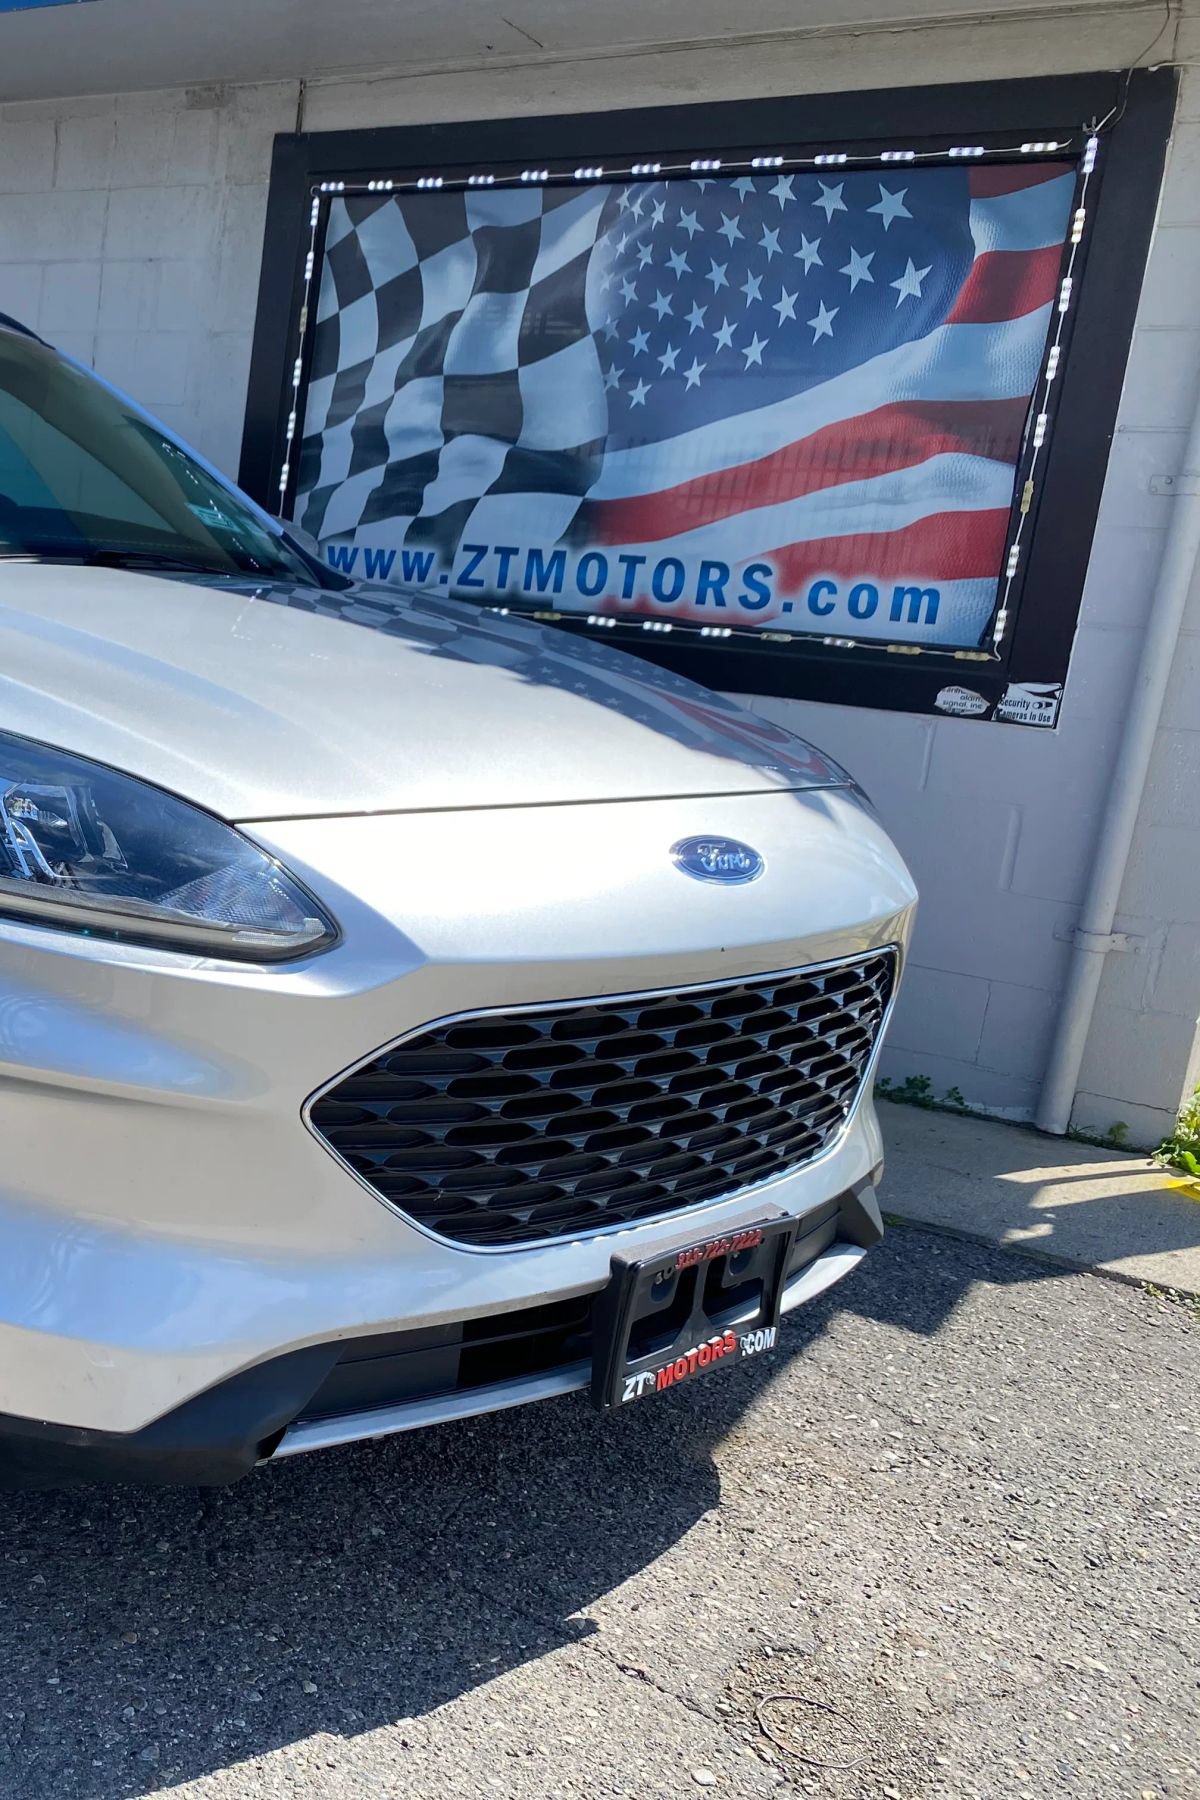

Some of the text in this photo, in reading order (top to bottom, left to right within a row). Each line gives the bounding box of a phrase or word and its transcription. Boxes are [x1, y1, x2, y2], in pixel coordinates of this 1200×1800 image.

[328, 544, 940, 625] www.ZTMOTORS.com
[1000, 697, 1031, 711] Security
[1029, 711, 1037, 721] In
[1038, 712, 1052, 723] Use
[697, 842, 751, 872] Ford
[656, 1329, 737, 1392] MOTORS
